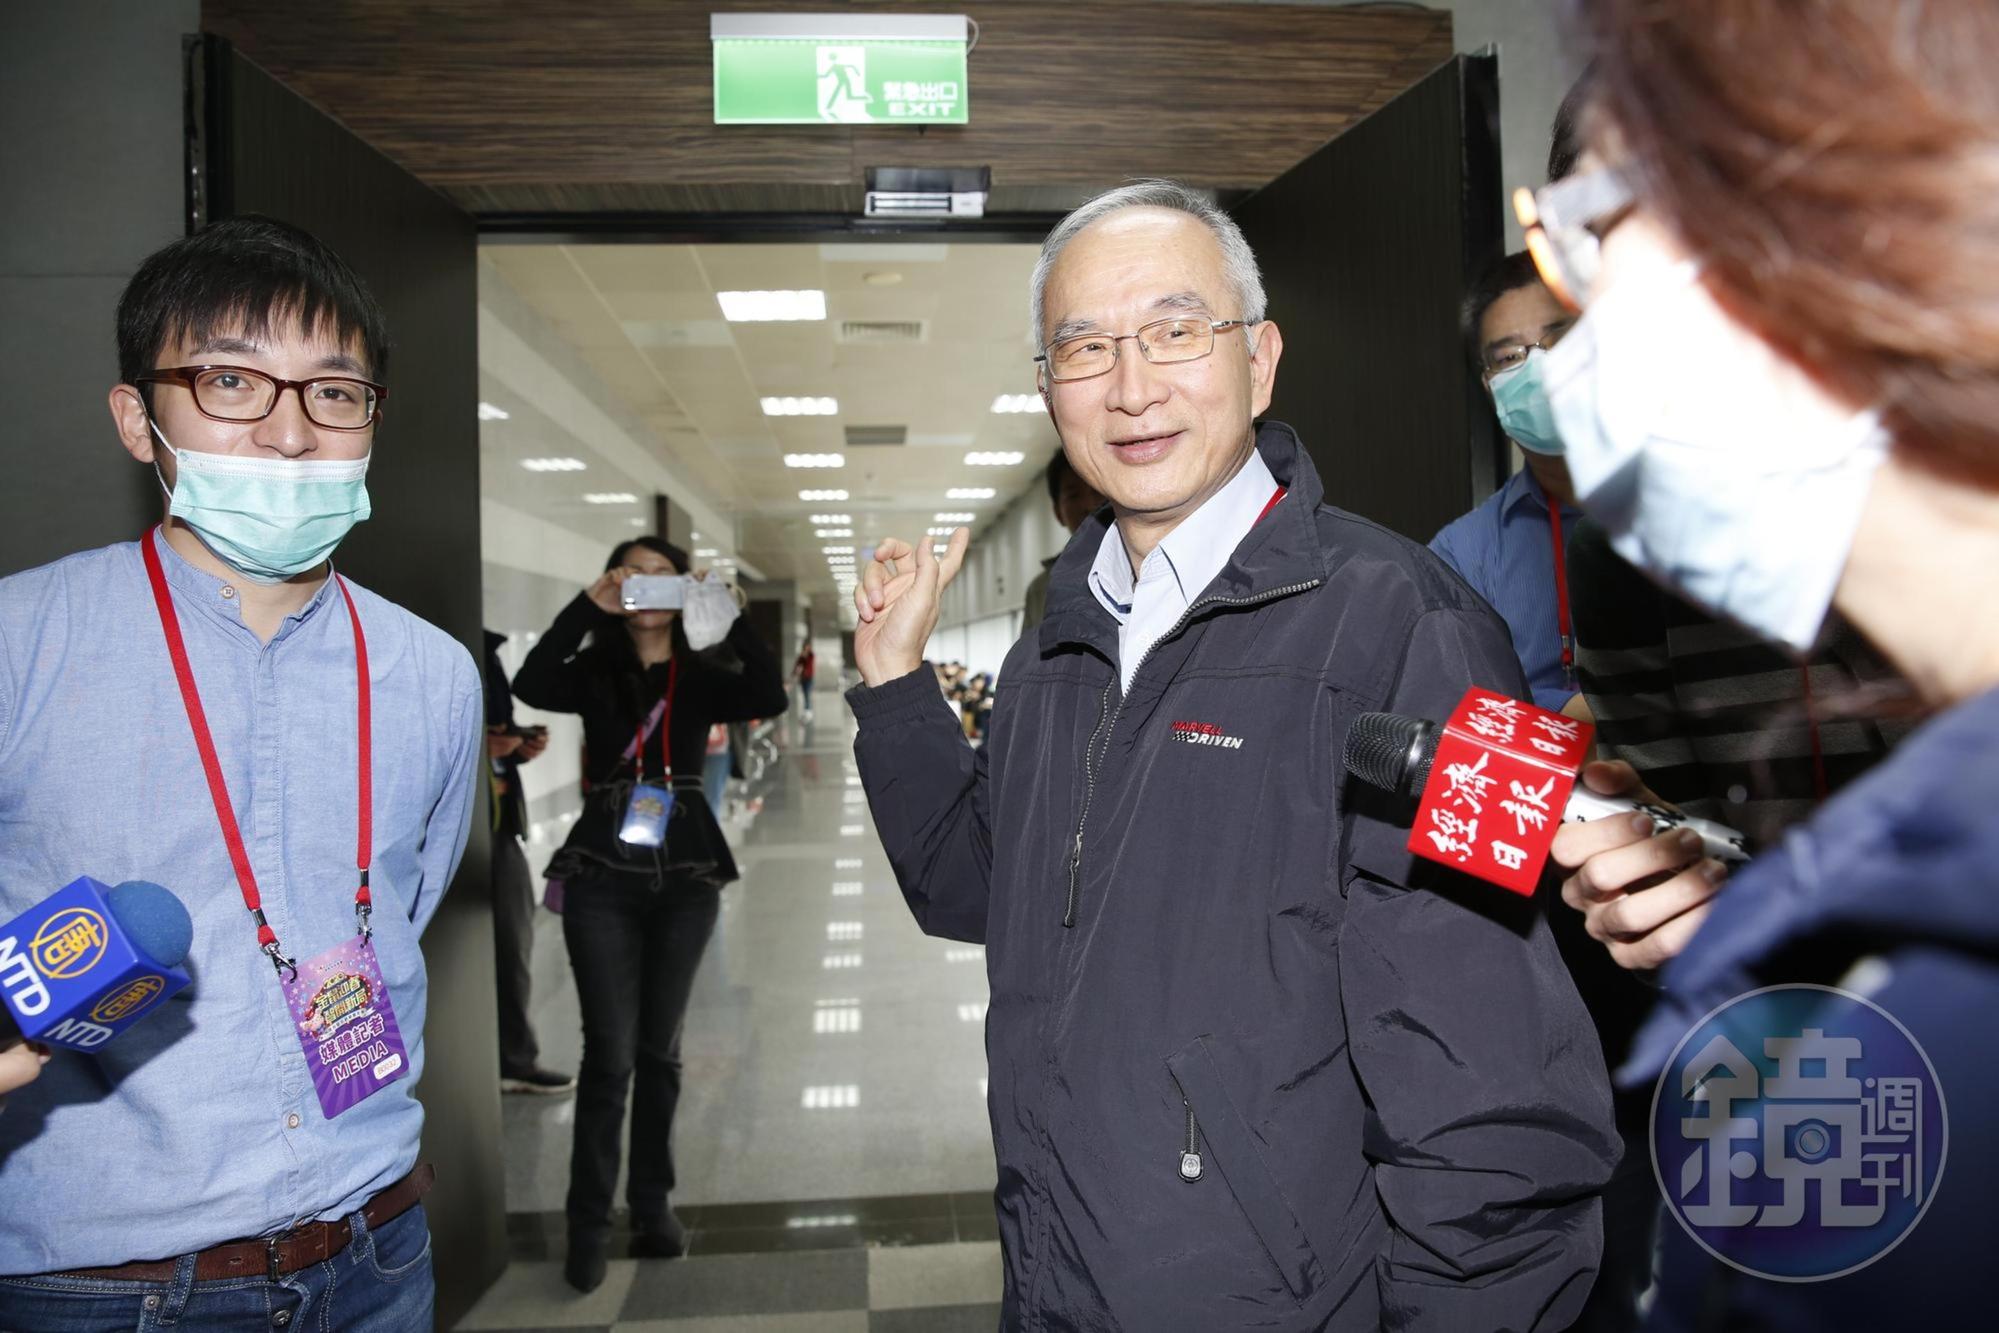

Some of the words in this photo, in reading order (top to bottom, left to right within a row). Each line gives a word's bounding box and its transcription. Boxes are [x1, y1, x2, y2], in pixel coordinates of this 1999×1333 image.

[882, 80, 958, 101] 緊急出口
[888, 102, 955, 117] EXIT
[1187, 732, 1244, 749] DRIVEN
[1427, 752, 1498, 865] 經濟
[1490, 776, 1555, 870] 日報
[0, 935, 51, 1017] NTD
[43, 1018, 113, 1047] NTD
[319, 1014, 385, 1065] 媒體記者
[332, 1041, 388, 1084] MEDIA
